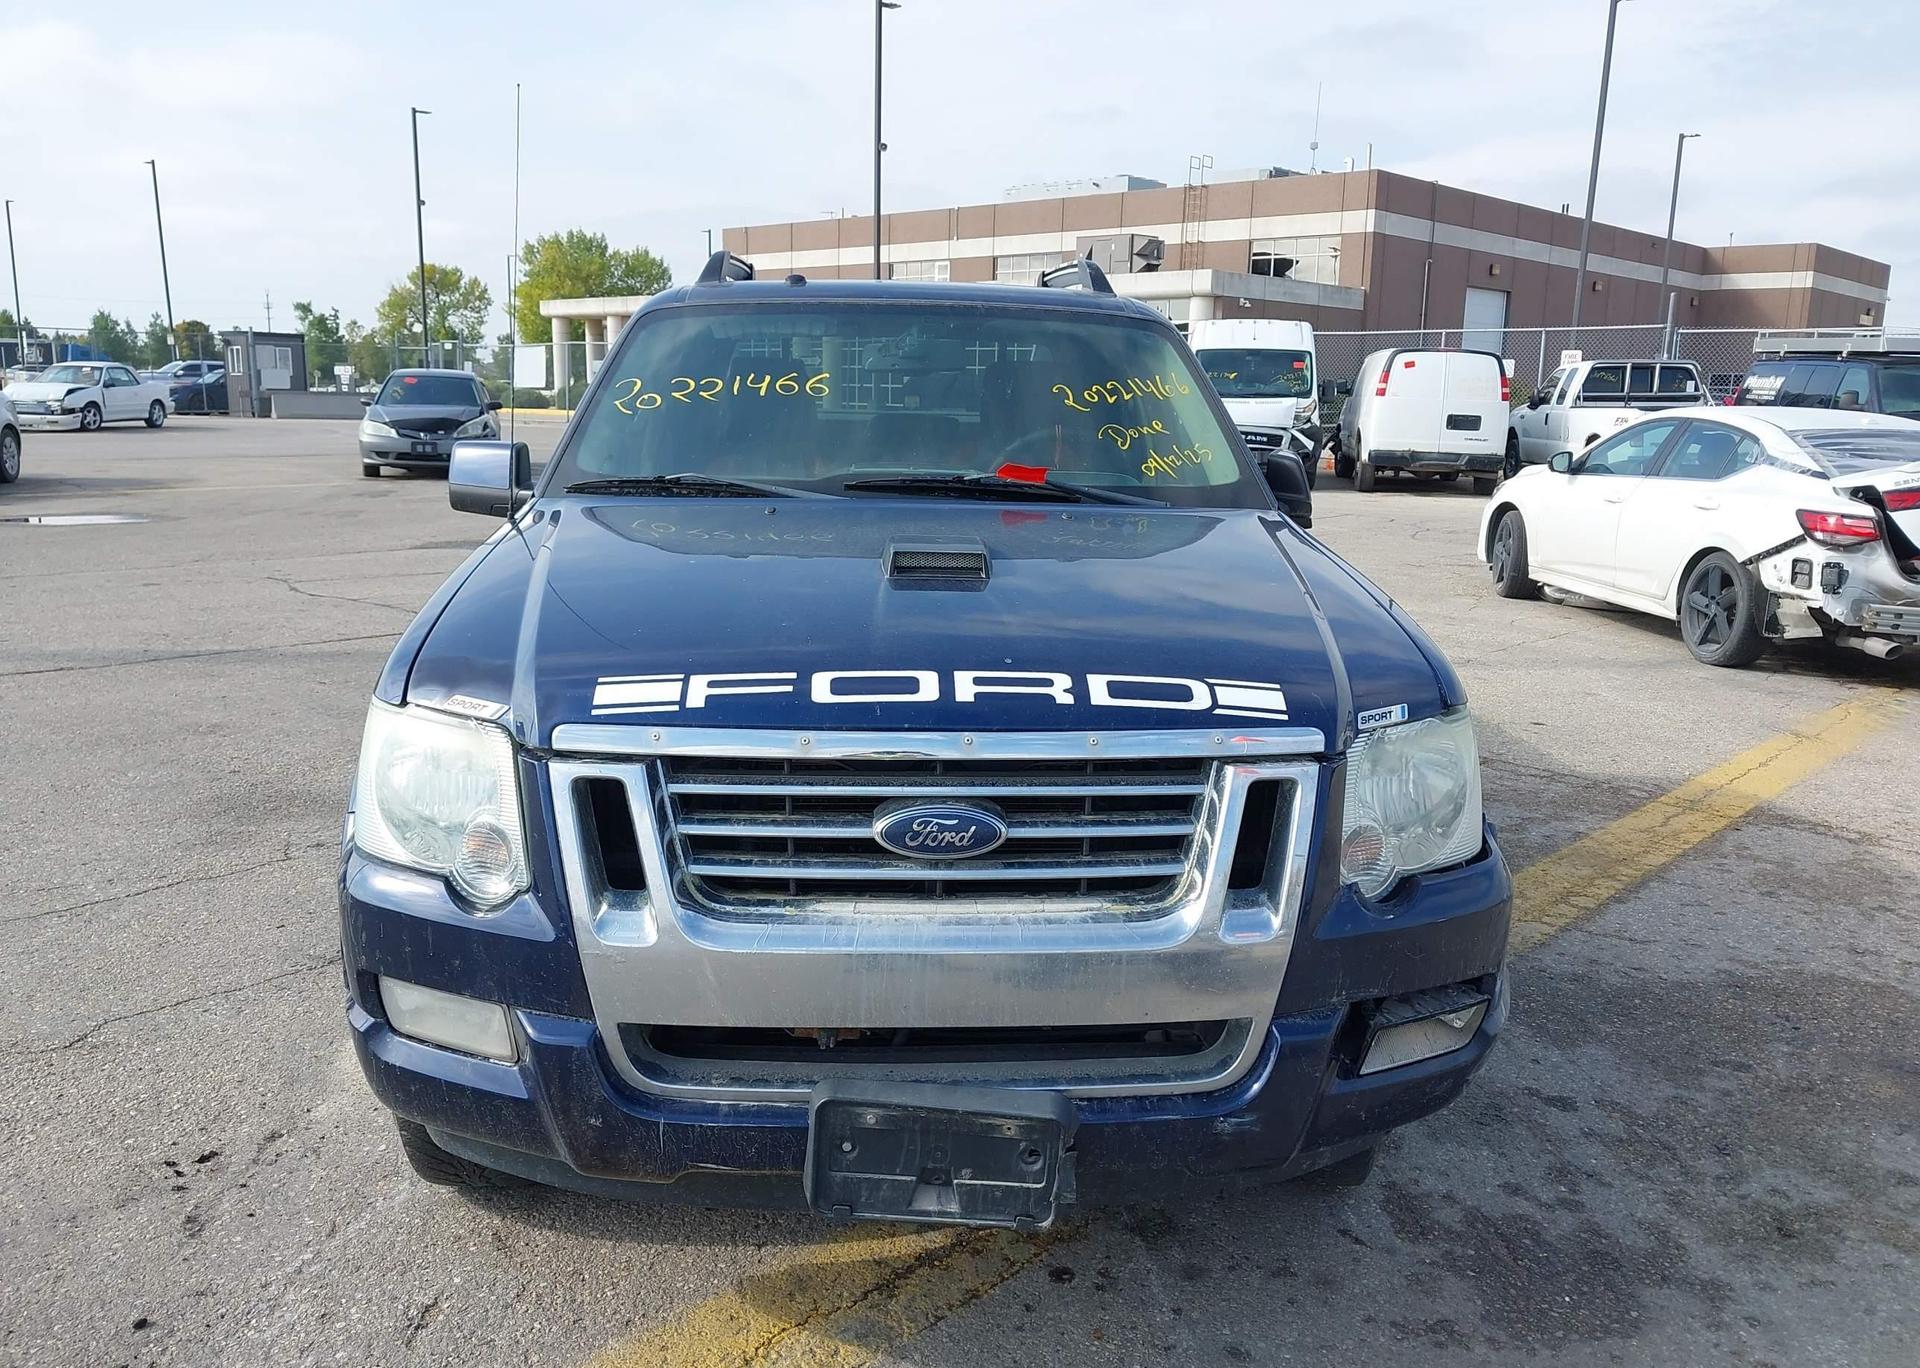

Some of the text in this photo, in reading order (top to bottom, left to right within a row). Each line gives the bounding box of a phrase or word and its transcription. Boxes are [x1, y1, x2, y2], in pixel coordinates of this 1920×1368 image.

[613, 371, 831, 415] 20221466
[1098, 419, 1171, 450] Done
[447, 697, 489, 713] SPORT
[686, 669, 1214, 711] FORD
[1360, 709, 1394, 724] SPORT
[905, 817, 976, 847] Ford
